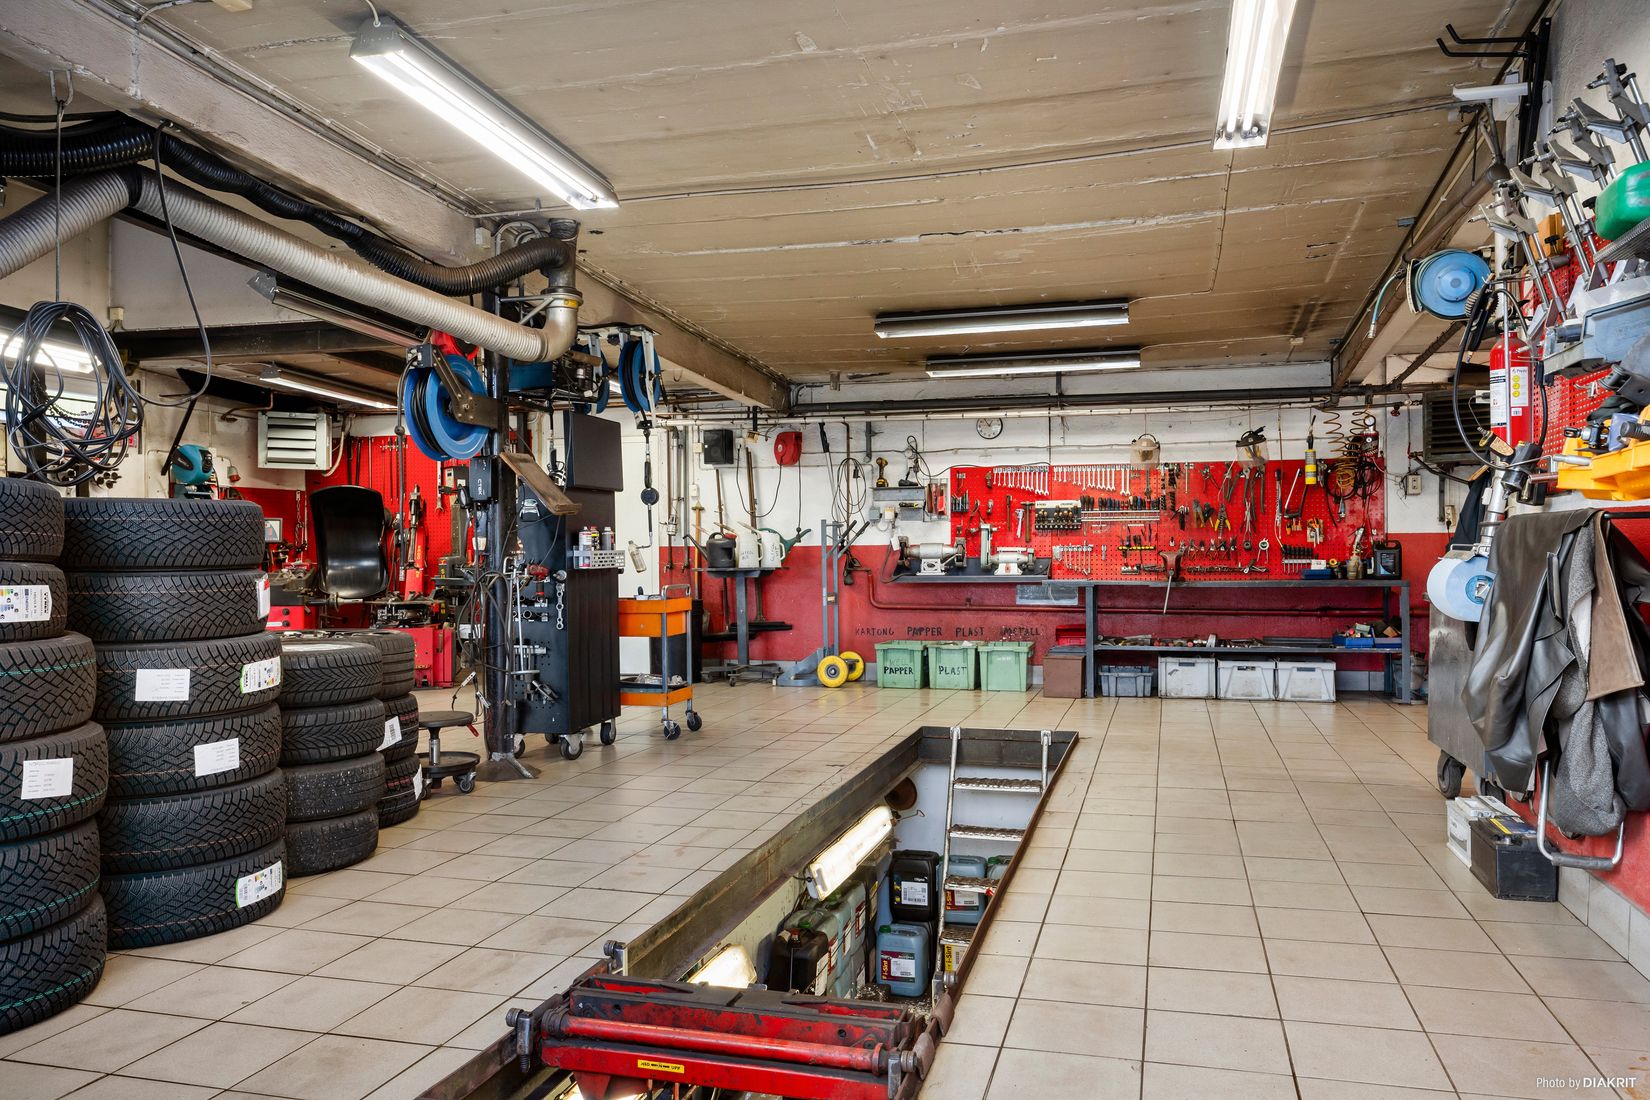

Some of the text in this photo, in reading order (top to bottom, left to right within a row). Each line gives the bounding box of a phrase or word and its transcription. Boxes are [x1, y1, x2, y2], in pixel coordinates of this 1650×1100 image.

[855, 627, 895, 636] KARTONG
[906, 626, 943, 637] PAPPER
[955, 626, 985, 638] PLAST
[883, 665, 914, 675] PAPPER
[938, 665, 967, 676] PLAST
